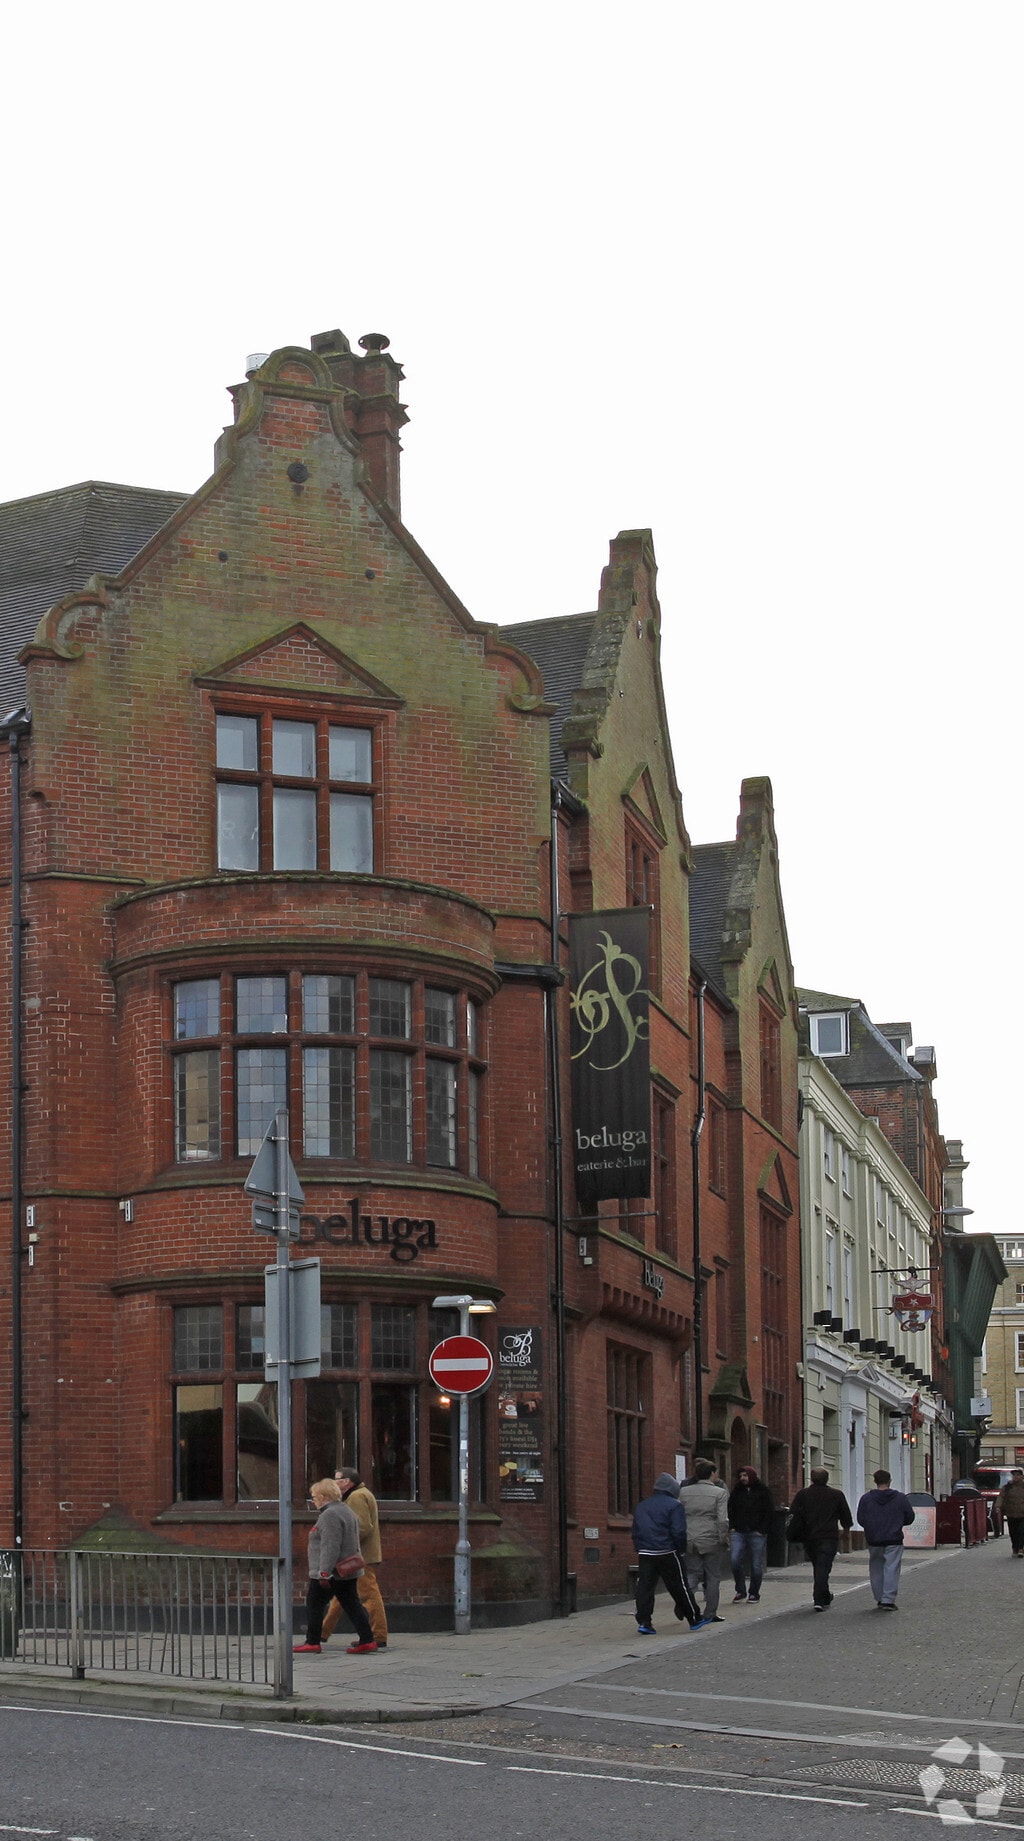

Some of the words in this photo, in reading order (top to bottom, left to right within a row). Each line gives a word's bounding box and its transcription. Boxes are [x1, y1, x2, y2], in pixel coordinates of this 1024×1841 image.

[576, 1125, 648, 1152] beluga
[577, 1160, 614, 1171] eaterie
[628, 1156, 646, 1167] bar
[499, 1352, 531, 1366] beluga
